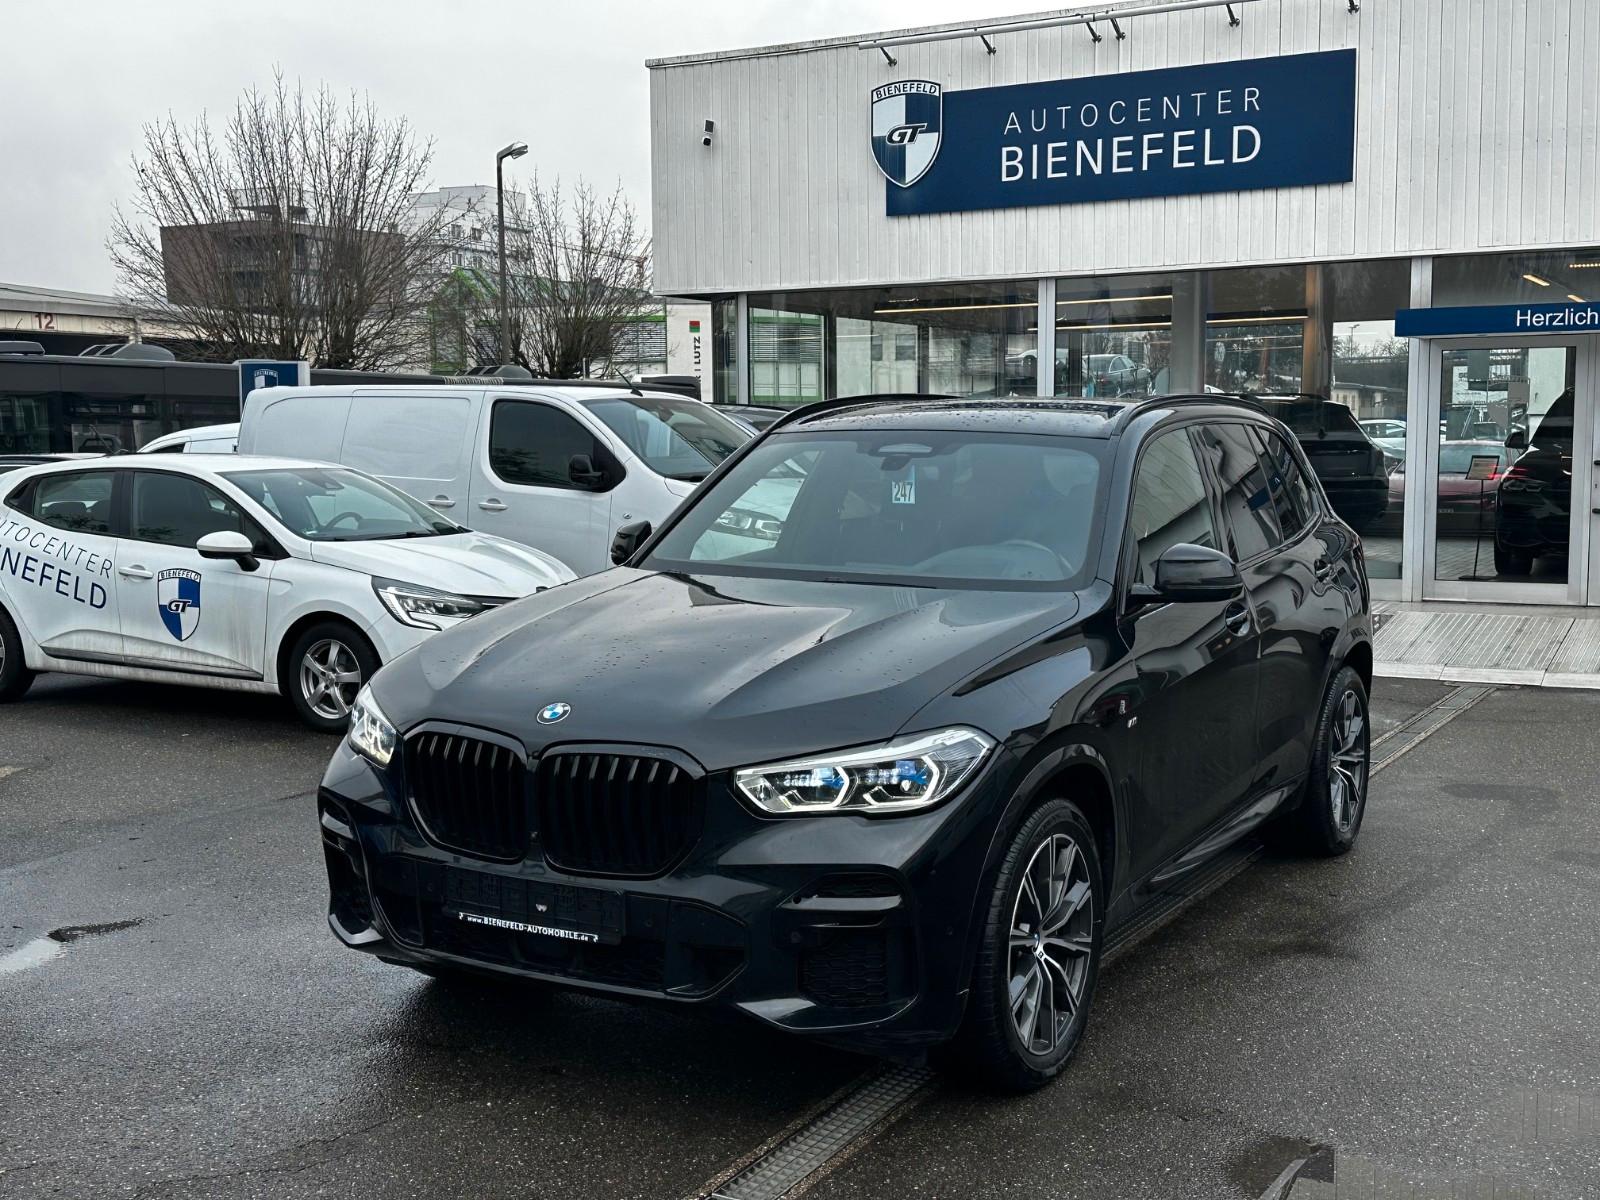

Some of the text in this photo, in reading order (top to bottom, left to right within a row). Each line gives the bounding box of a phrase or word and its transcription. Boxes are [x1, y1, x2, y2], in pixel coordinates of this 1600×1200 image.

[876, 83, 937, 99] BIENEFELD
[1004, 87, 1260, 135] AUTOCENTER
[886, 123, 928, 145] GT
[1001, 124, 1262, 182] BIENEFELD
[35, 312, 55, 330] 12
[1516, 307, 1599, 327] Herzlich
[693, 336, 701, 365] LUTZ
[894, 481, 913, 502] 247
[0, 519, 113, 579] TOCENTER
[0, 544, 107, 610] NEFELD
[160, 570, 199, 581] BIENEFELD
[167, 599, 192, 613] GT
